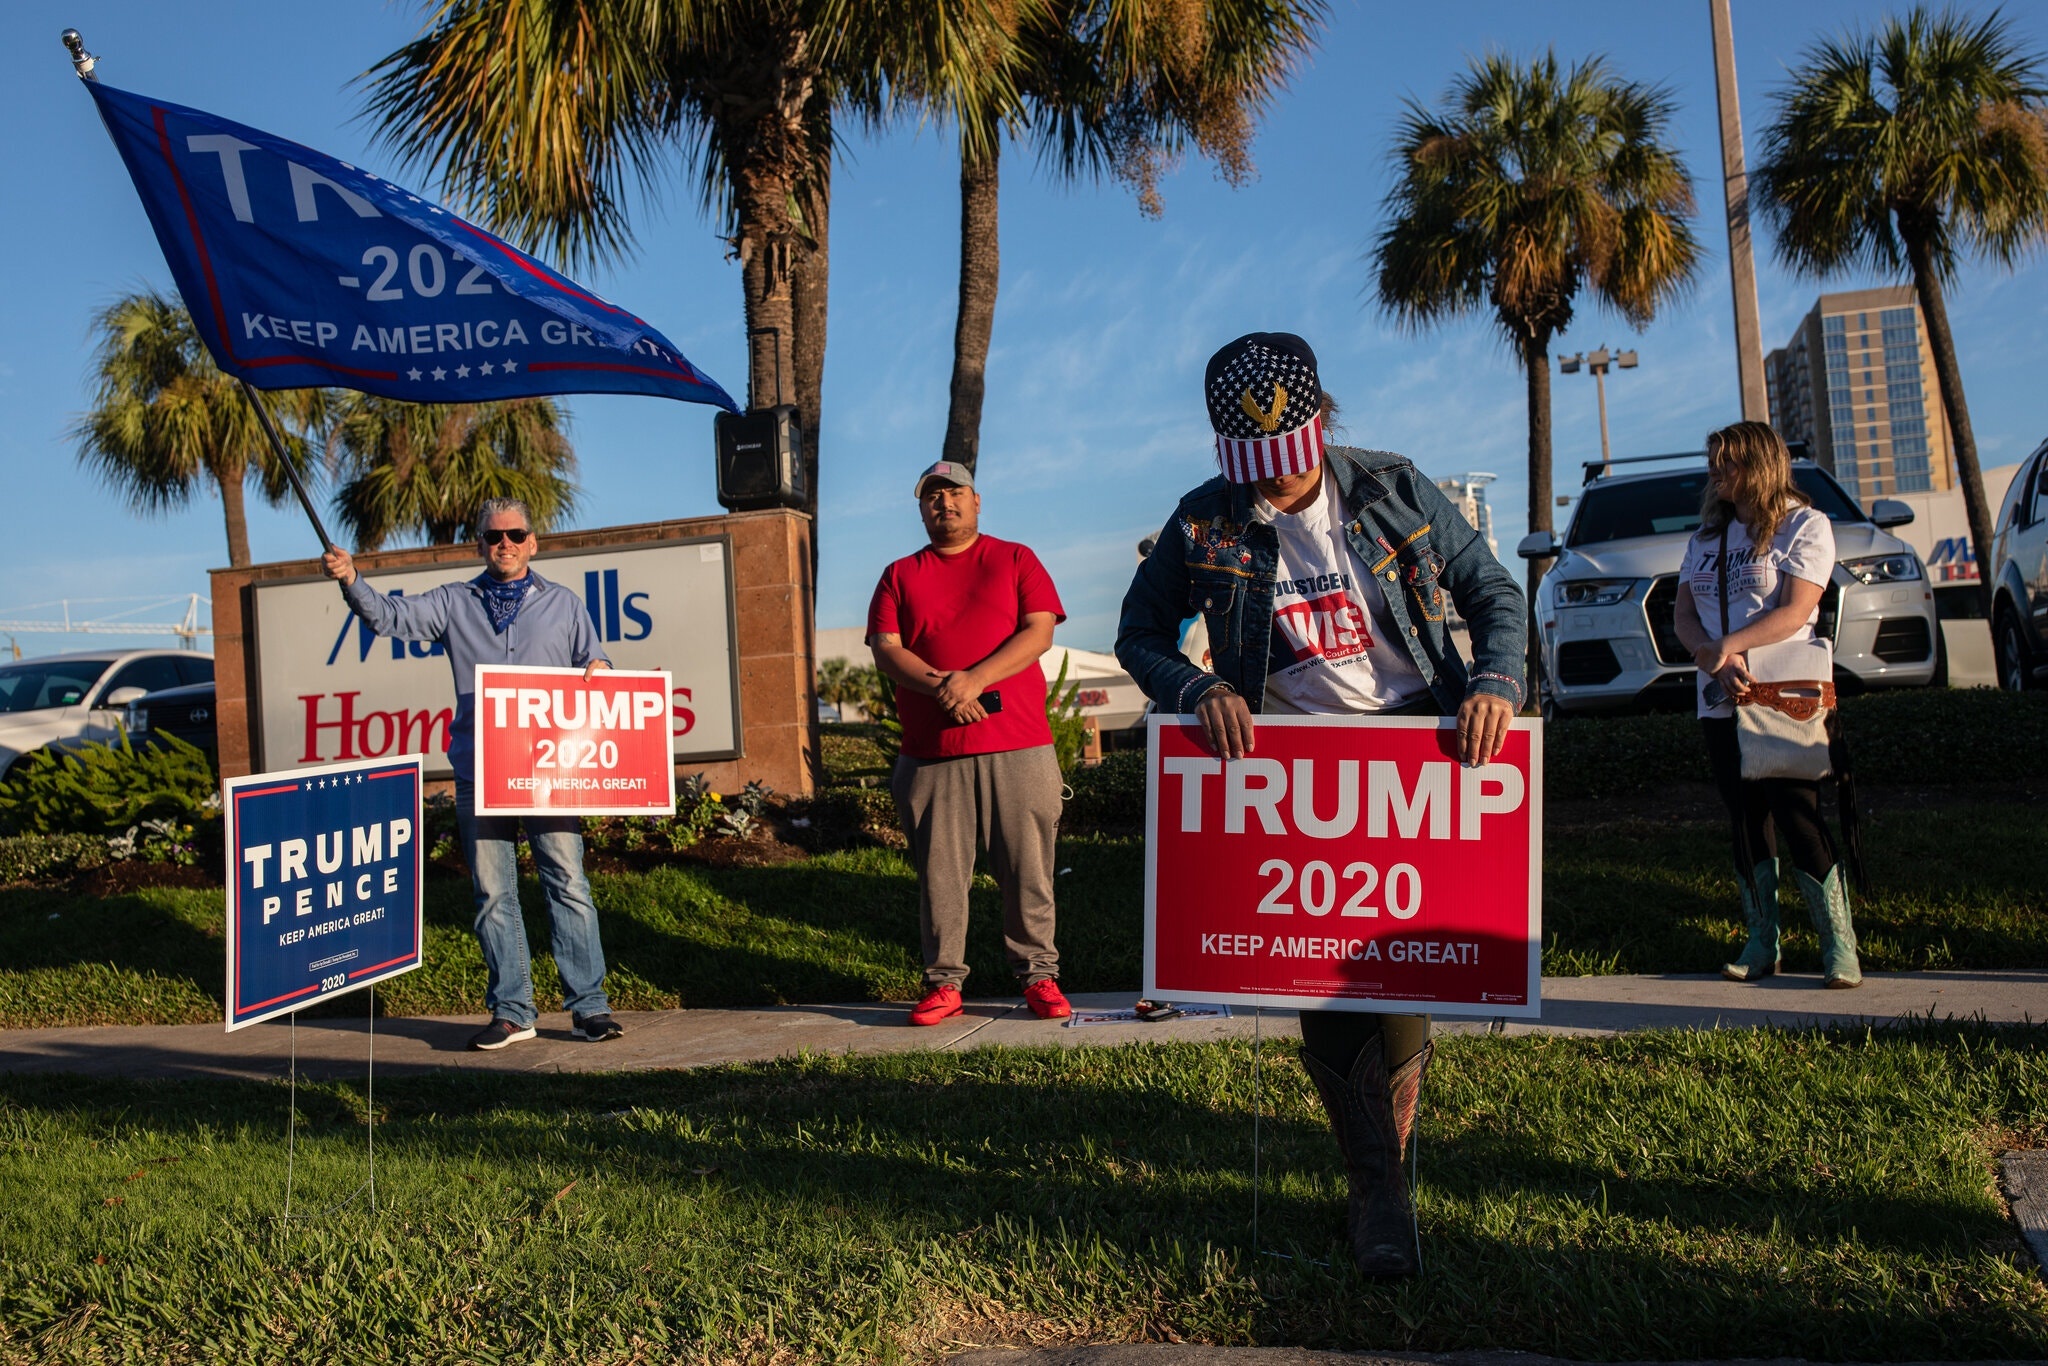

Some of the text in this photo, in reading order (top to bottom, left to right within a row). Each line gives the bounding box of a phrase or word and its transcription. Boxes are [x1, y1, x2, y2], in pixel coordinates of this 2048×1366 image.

[241, 312, 338, 348] KEEP
[351, 320, 530, 354] AMERICA
[1325, 647, 1350, 658] Court
[484, 688, 664, 730] TRUMP
[536, 739, 618, 769] 2020
[508, 778, 647, 790] KEEP AMERICA GREAT!
[1163, 756, 1525, 841] TRUMP
[244, 817, 412, 889] TRUMP
[263, 868, 398, 925] PENCE
[1256, 858, 1422, 920] 2020
[279, 906, 385, 947] KEEP AMERICA GREAT!
[1201, 933, 1479, 965] KEEP AMERICA GREAT!
[321, 972, 345, 992] 2020
